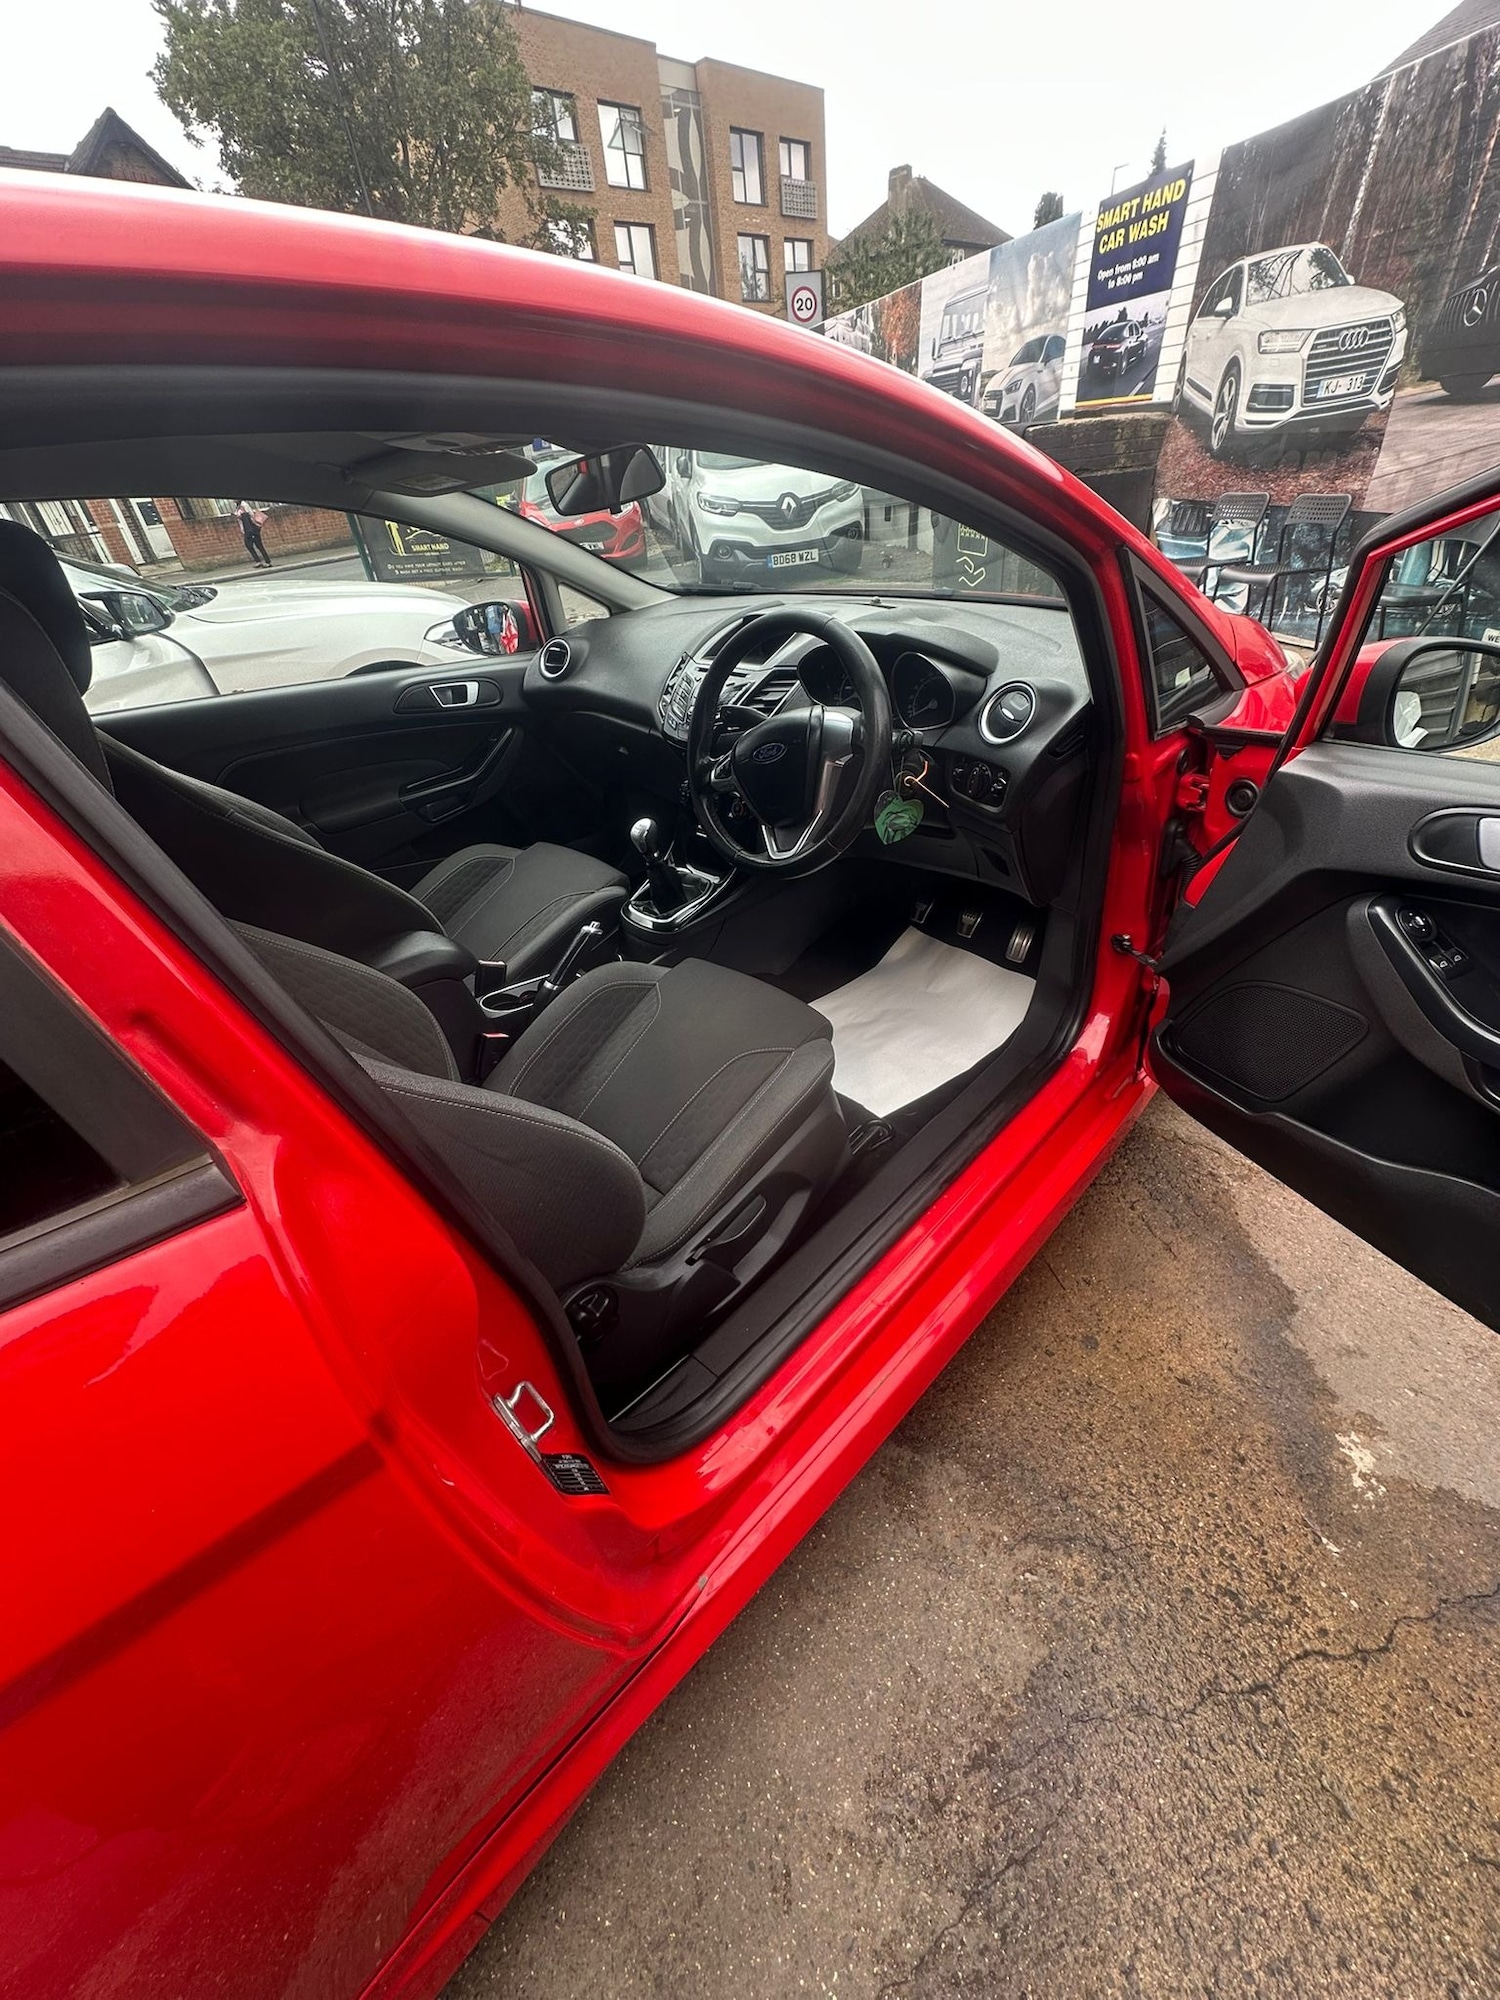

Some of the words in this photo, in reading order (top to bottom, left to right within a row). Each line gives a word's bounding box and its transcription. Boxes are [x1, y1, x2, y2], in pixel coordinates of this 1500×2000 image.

[1096, 197, 1141, 233] SMART
[1141, 178, 1186, 214] HAND
[1099, 228, 1125, 254] CAR
[1128, 210, 1170, 244] WASH
[1097, 269, 1114, 282] Open
[1114, 263, 1132, 275] from
[1147, 252, 1160, 265] am
[1107, 279, 1116, 289] to
[1131, 271, 1144, 284] pm
[796, 297, 813, 311] 20
[1346, 375, 1365, 391] 313
[798, 551, 817, 562] WZL
